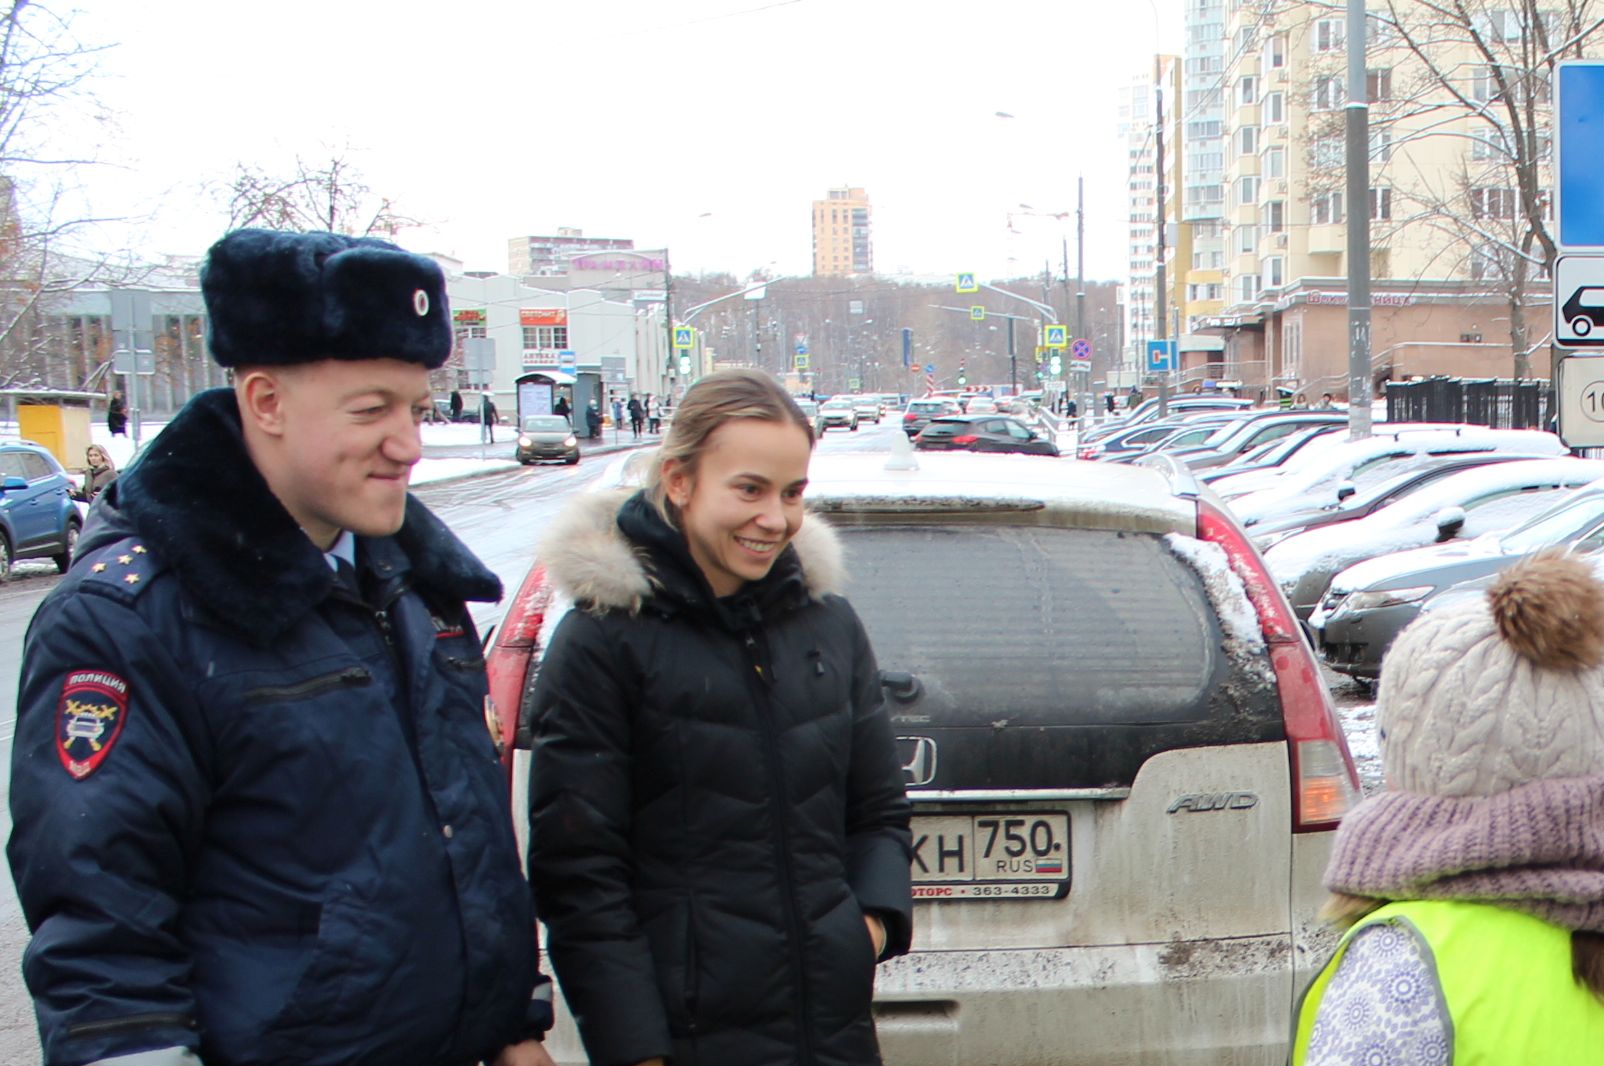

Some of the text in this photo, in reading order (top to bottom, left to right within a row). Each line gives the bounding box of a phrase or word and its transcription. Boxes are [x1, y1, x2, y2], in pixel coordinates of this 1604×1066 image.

[68, 673, 127, 694] ПОЛИЦИЯ
[1166, 790, 1259, 815] AWD
[977, 819, 1053, 859] 750
[996, 860, 1033, 873] RUS
[972, 886, 1050, 896] 363-4333
